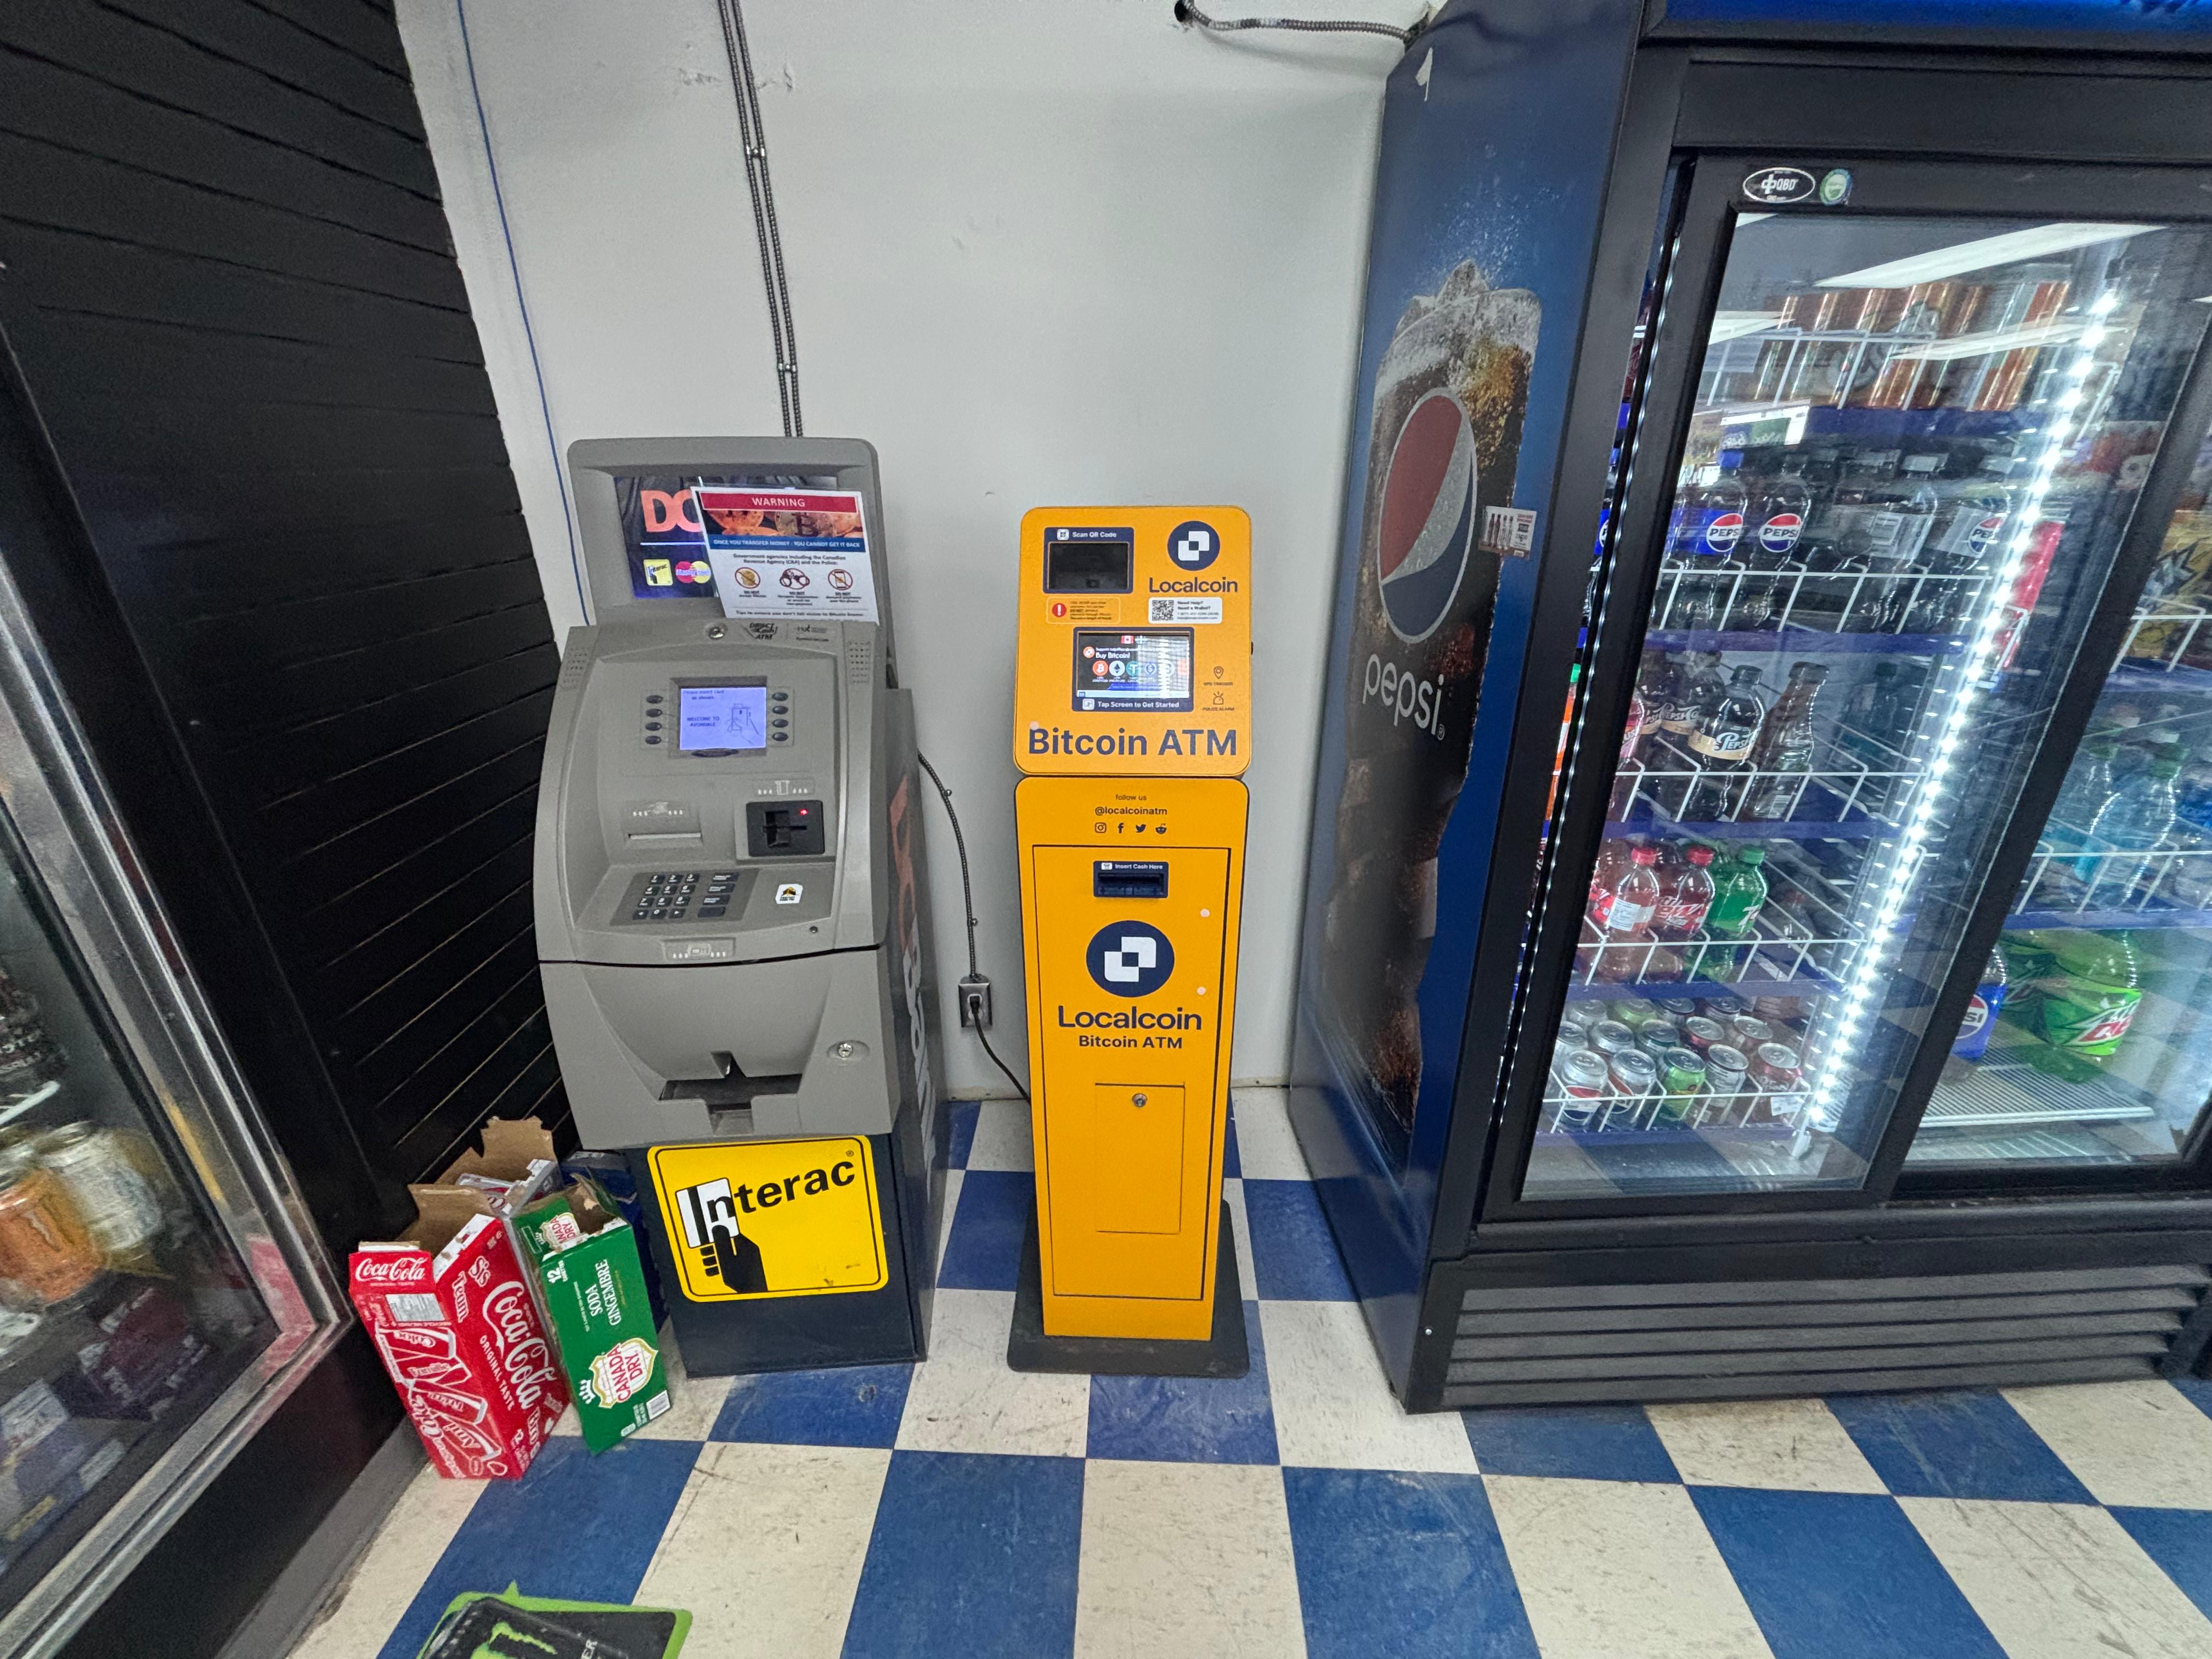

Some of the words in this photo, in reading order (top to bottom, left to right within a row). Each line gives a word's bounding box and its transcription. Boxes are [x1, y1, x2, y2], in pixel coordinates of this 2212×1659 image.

[751, 497, 806, 508] WARNING
[1709, 528, 1741, 537] PEPS
[1149, 577, 1238, 593] Localcoin
[1362, 653, 1445, 736] pepsi
[1029, 727, 1147, 755] Bitcoin
[1158, 729, 1237, 756] ATM
[1094, 806, 1167, 816] @localcoinatm
[1058, 1005, 1202, 1030] Localcoin
[1079, 1035, 1138, 1048] Bitcoin
[1142, 1036, 1183, 1049] ATM
[687, 1160, 855, 1246] Interac
[355, 1257, 428, 1282] Coca-Cola
[547, 1267, 562, 1284] 12
[585, 1284, 603, 1317] SODA
[595, 1259, 622, 1326] GINGEMBRE
[482, 1281, 557, 1410] Coca-Cola
[479, 1334, 503, 1382] ORIGINAL
[499, 1379, 515, 1412] TASTE
[606, 1345, 631, 1402] CANADA
[624, 1353, 644, 1381] DRY
